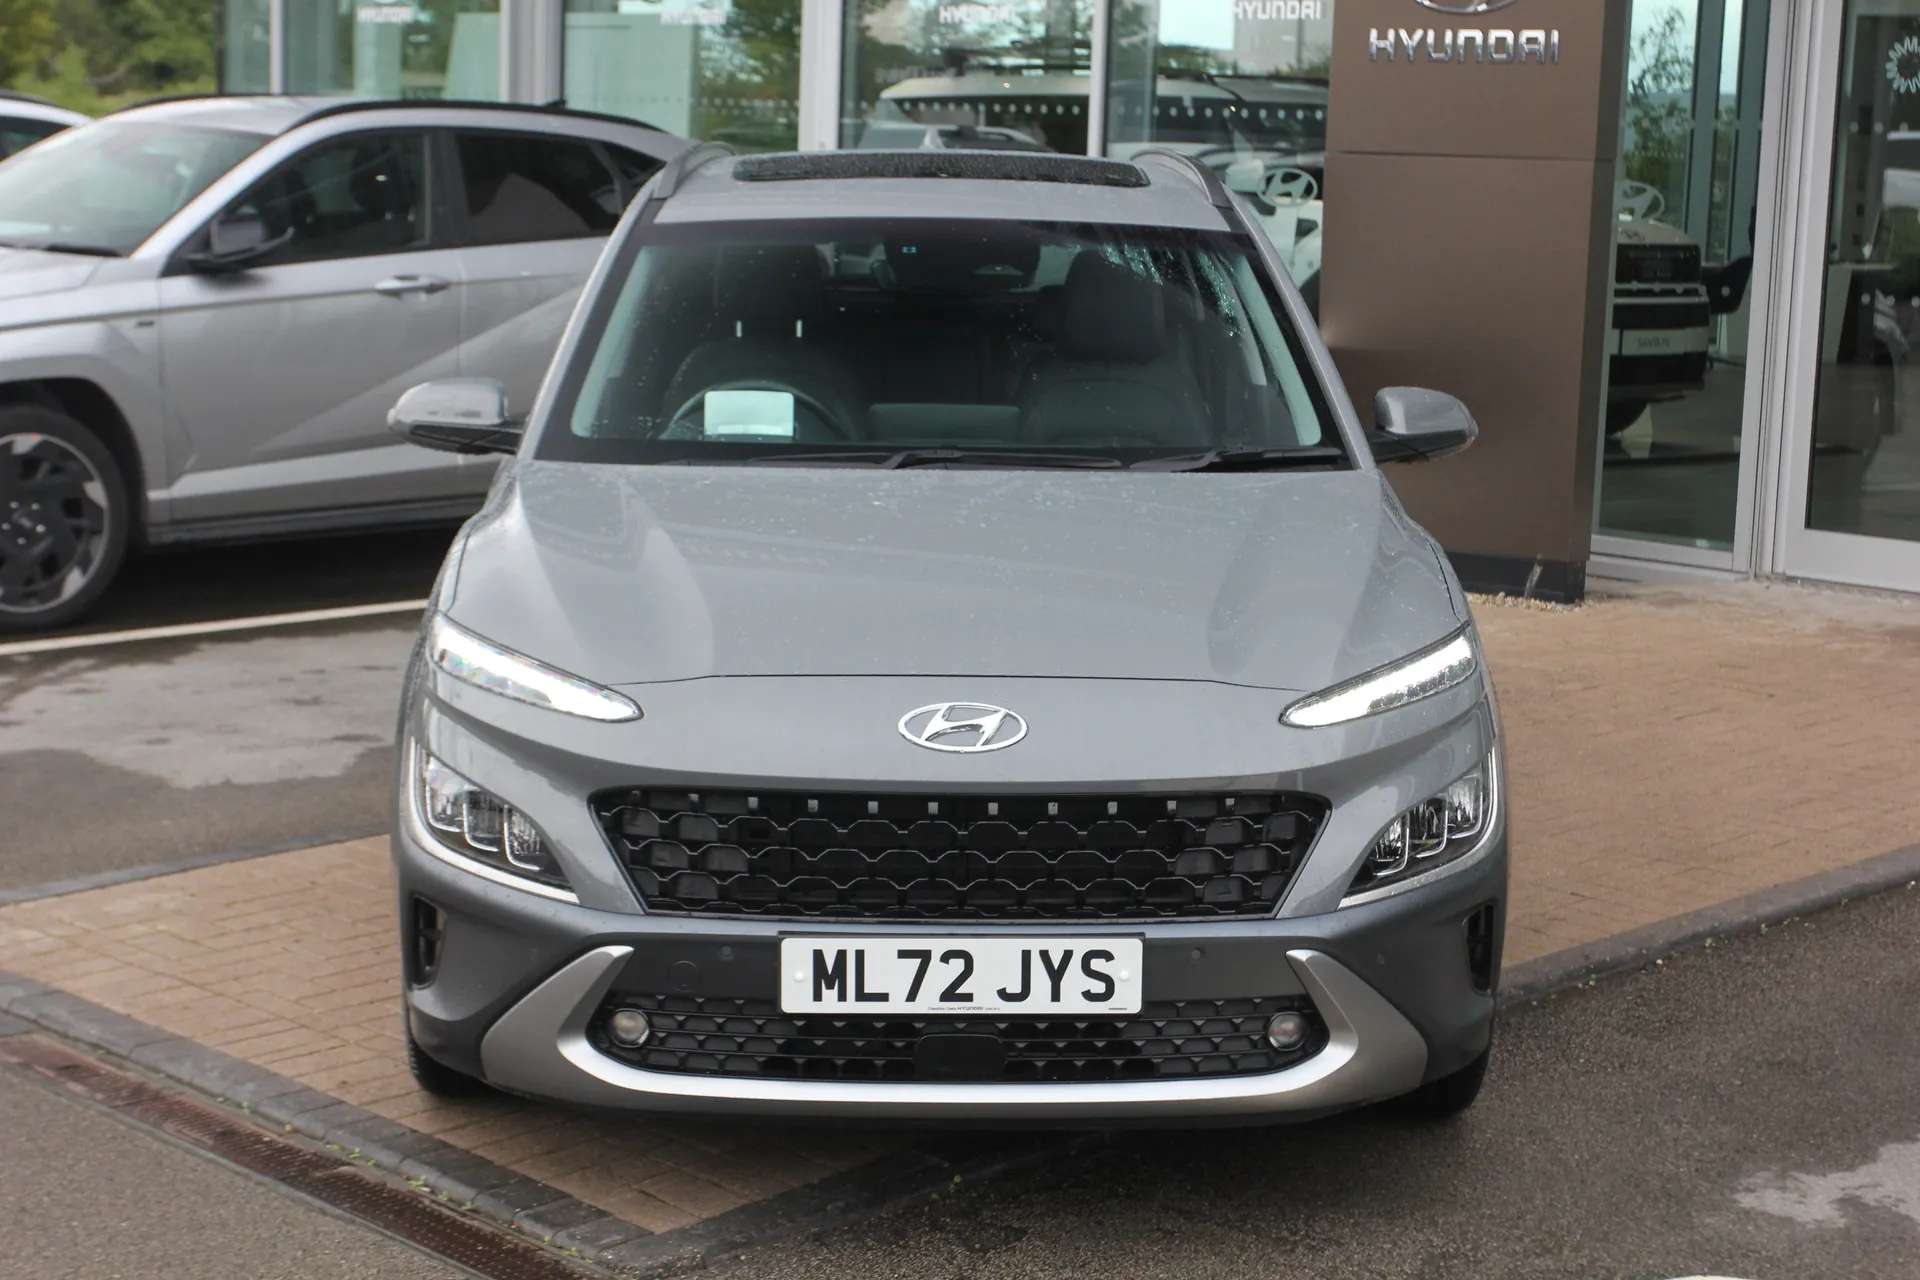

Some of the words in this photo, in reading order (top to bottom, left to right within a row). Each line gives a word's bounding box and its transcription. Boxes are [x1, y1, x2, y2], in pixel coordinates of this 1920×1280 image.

[1232, 0, 1322, 20] HYUNDAI
[1368, 27, 1560, 65] HYUNDAI
[812, 949, 974, 1002] ML72
[996, 949, 1116, 1002] JYS
